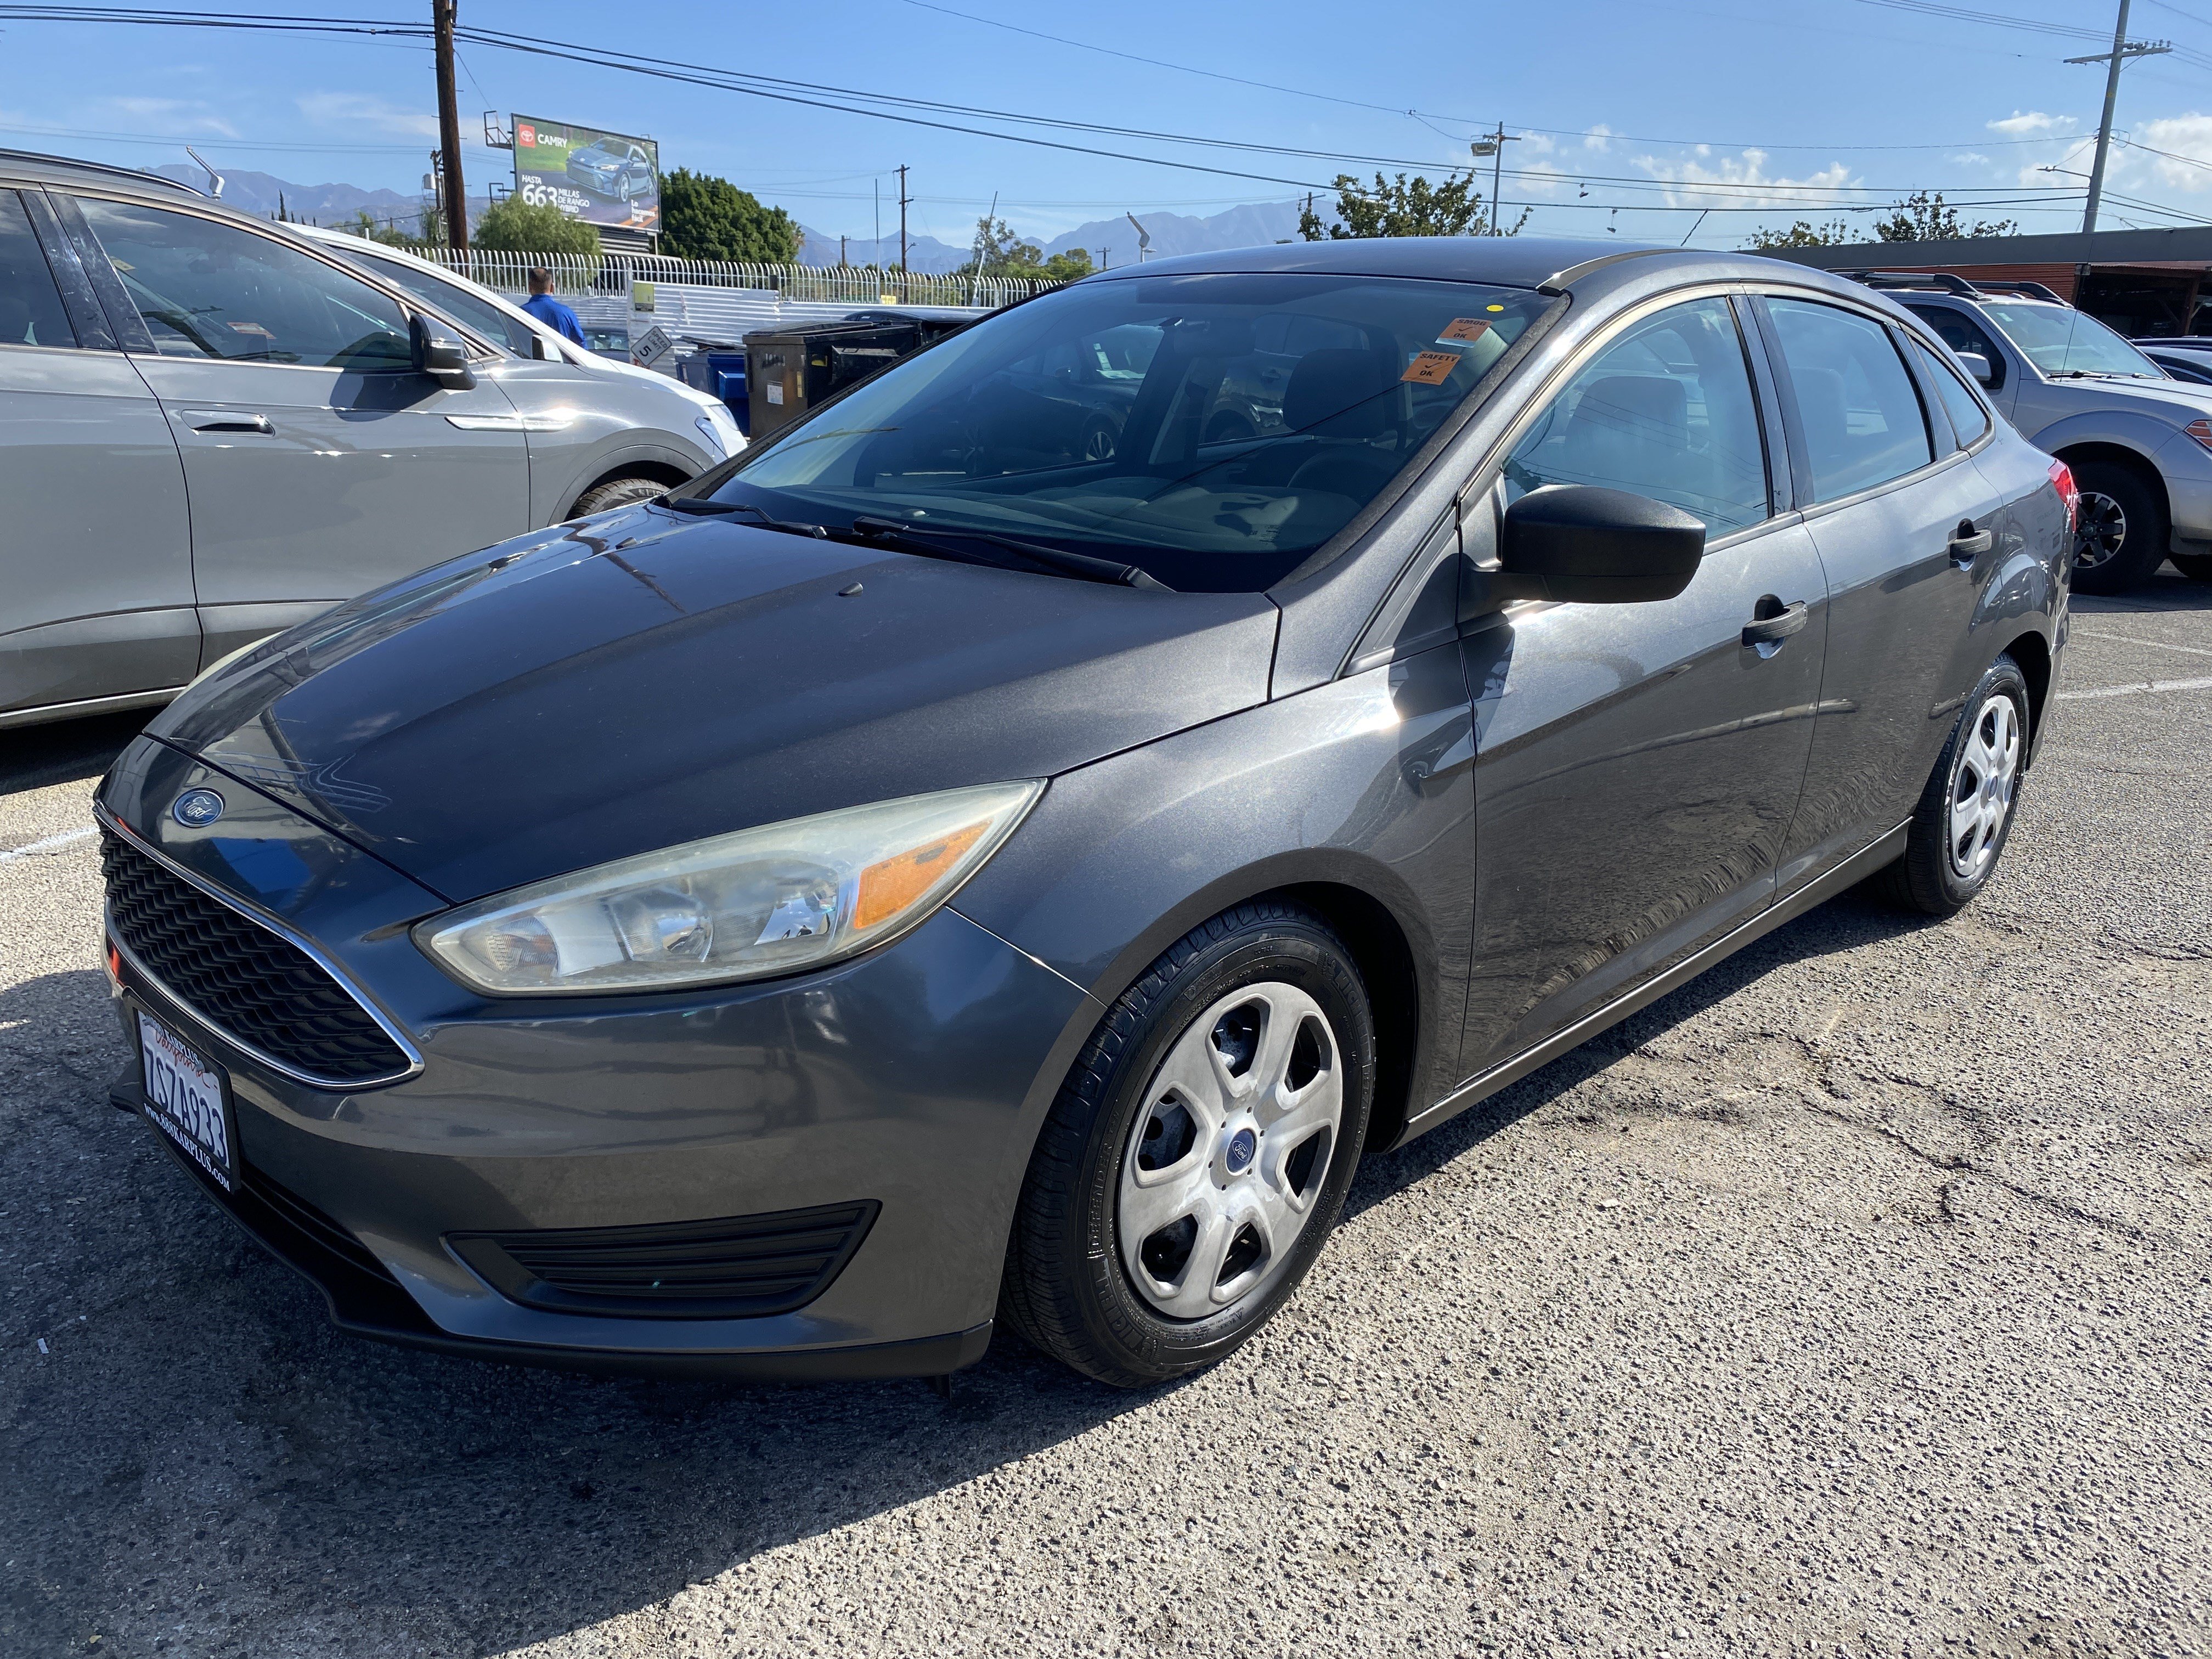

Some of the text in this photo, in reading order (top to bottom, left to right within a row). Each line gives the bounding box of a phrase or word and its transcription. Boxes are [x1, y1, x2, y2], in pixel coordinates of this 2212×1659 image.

[538, 133, 567, 148] CAMRY
[522, 174, 542, 184] HASTA
[522, 184, 557, 208] 663
[558, 188, 580, 198] MILLAS
[558, 196, 590, 207] DE RANGO
[648, 336, 662, 351] LIMIT
[651, 330, 668, 348] SPEED
[639, 345, 652, 357] 5
[1420, 353, 1458, 362] SAFETY
[144, 1043, 227, 1165] 7SZA933
[1234, 1143, 1248, 1160] Ford
